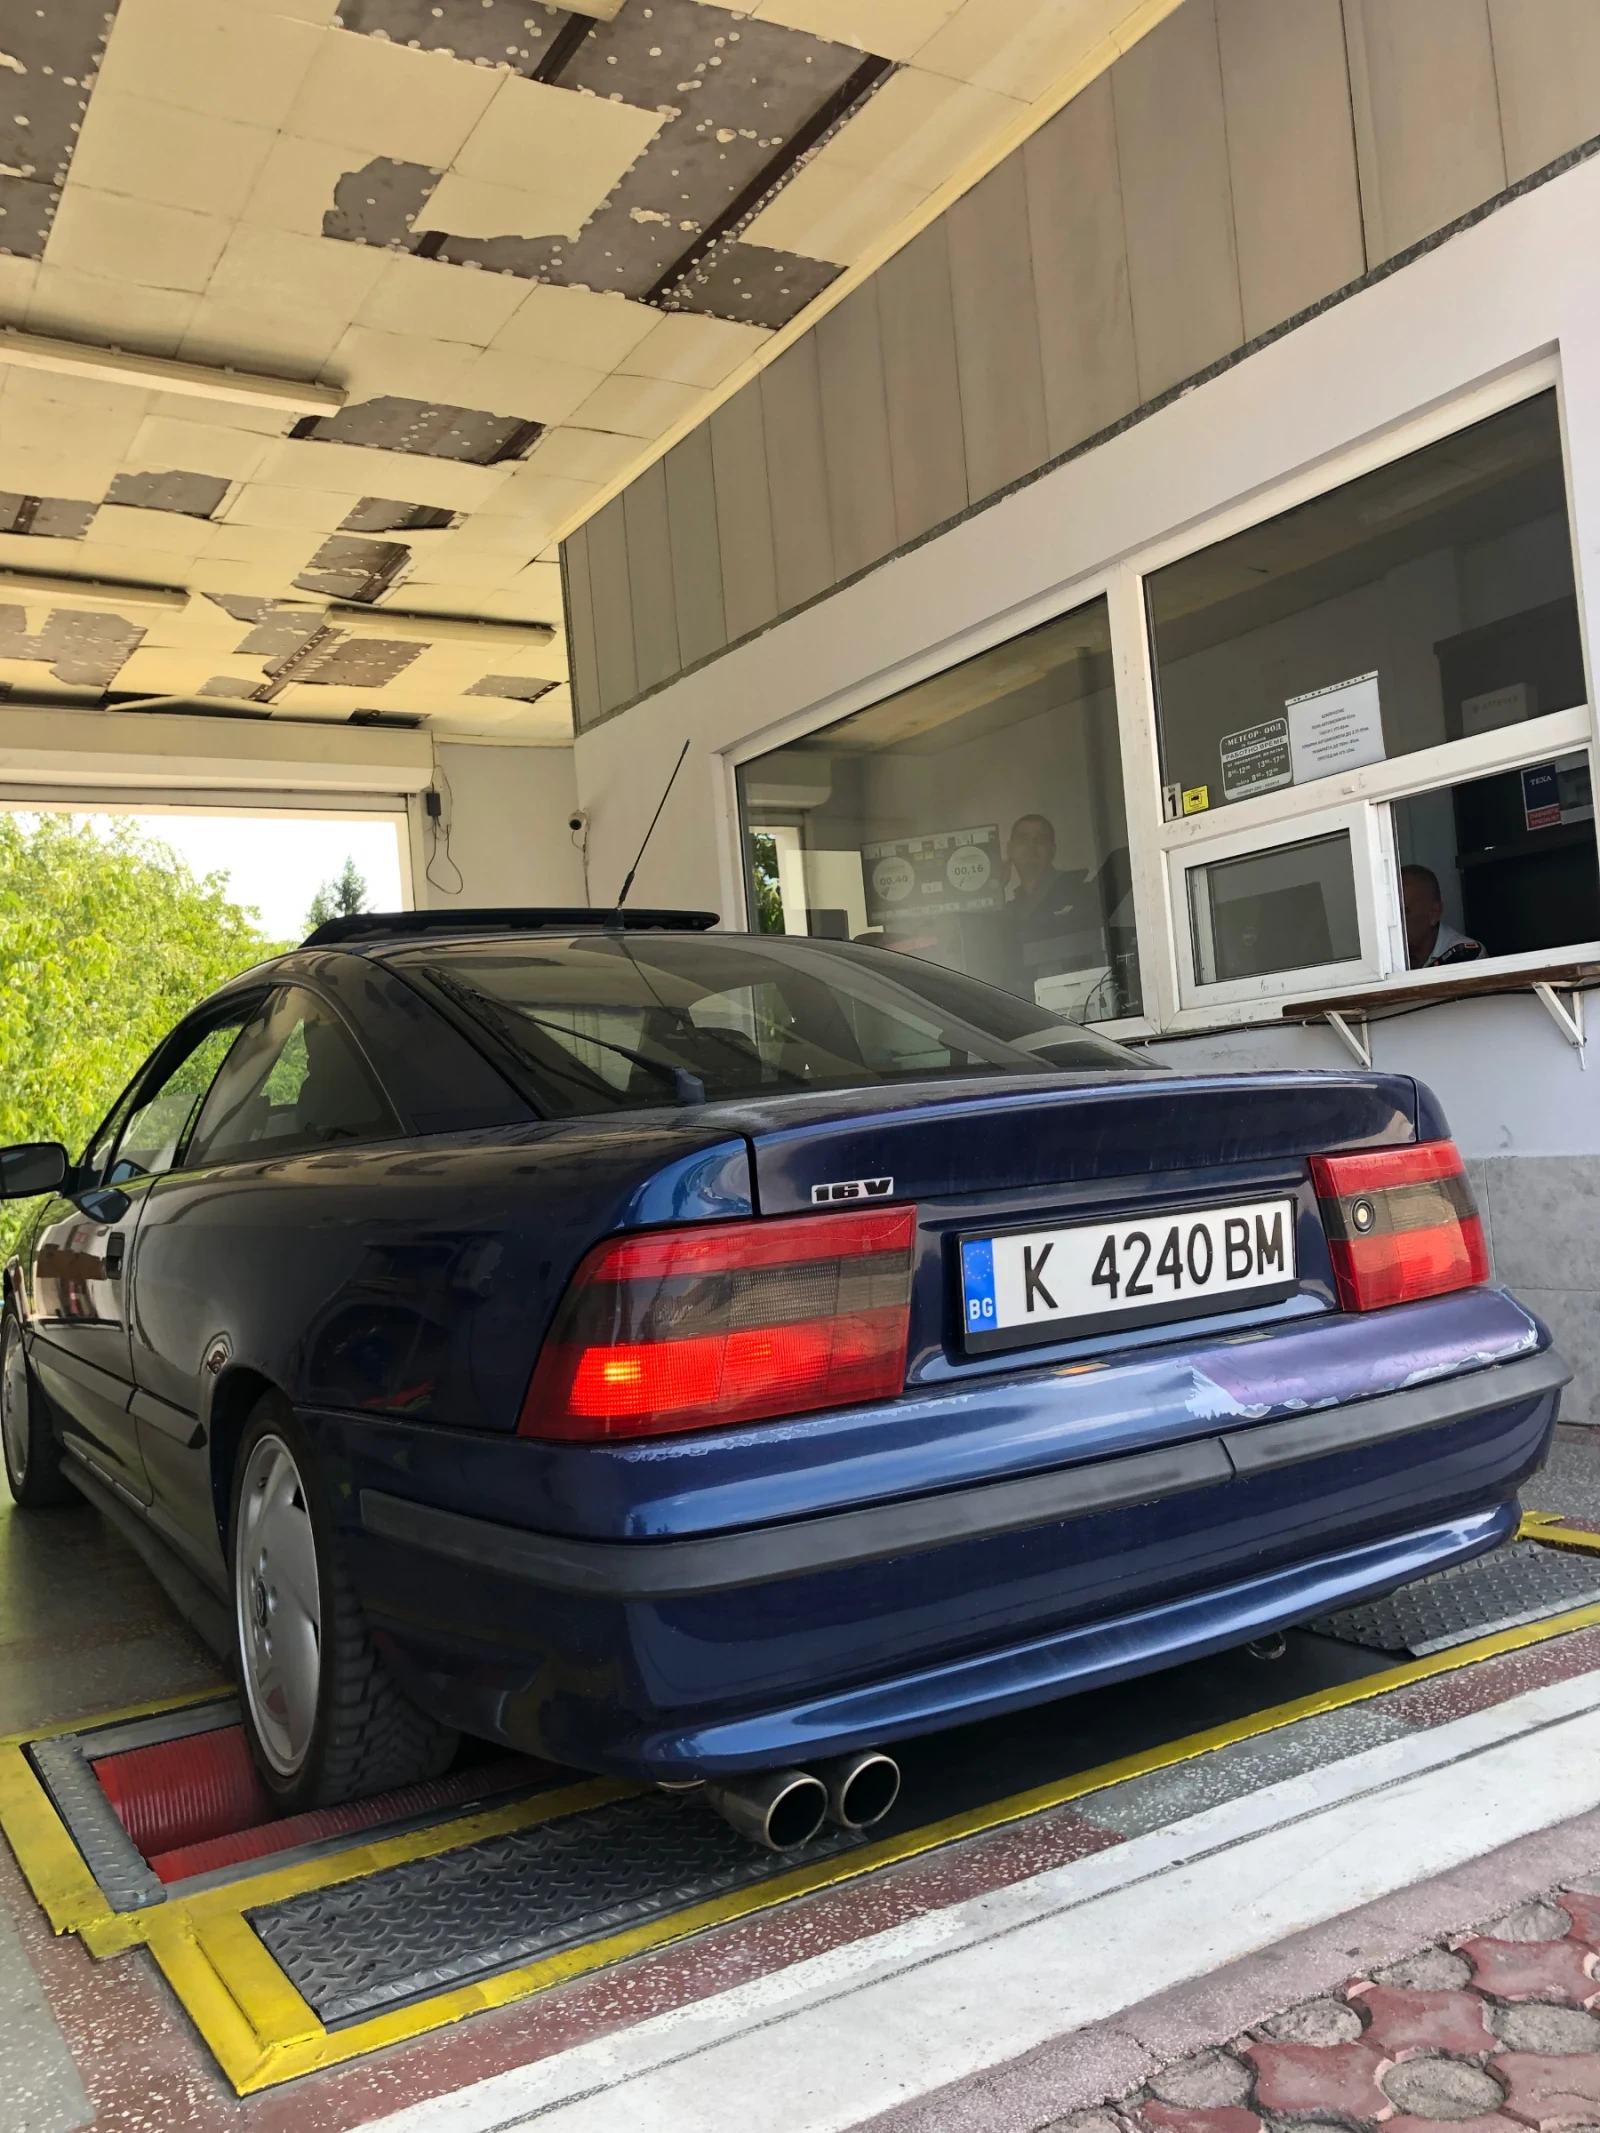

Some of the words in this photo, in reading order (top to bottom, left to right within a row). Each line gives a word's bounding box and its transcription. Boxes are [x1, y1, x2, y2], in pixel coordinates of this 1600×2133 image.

[1264, 723, 1282, 734] ООД
[1226, 746, 1259, 760] РАБОТНО
[1260, 738, 1284, 750] ВРЕМЕ
[1529, 775, 1552, 786] TEXA
[954, 864, 984, 876] 00,16
[969, 1297, 994, 1320] BG
